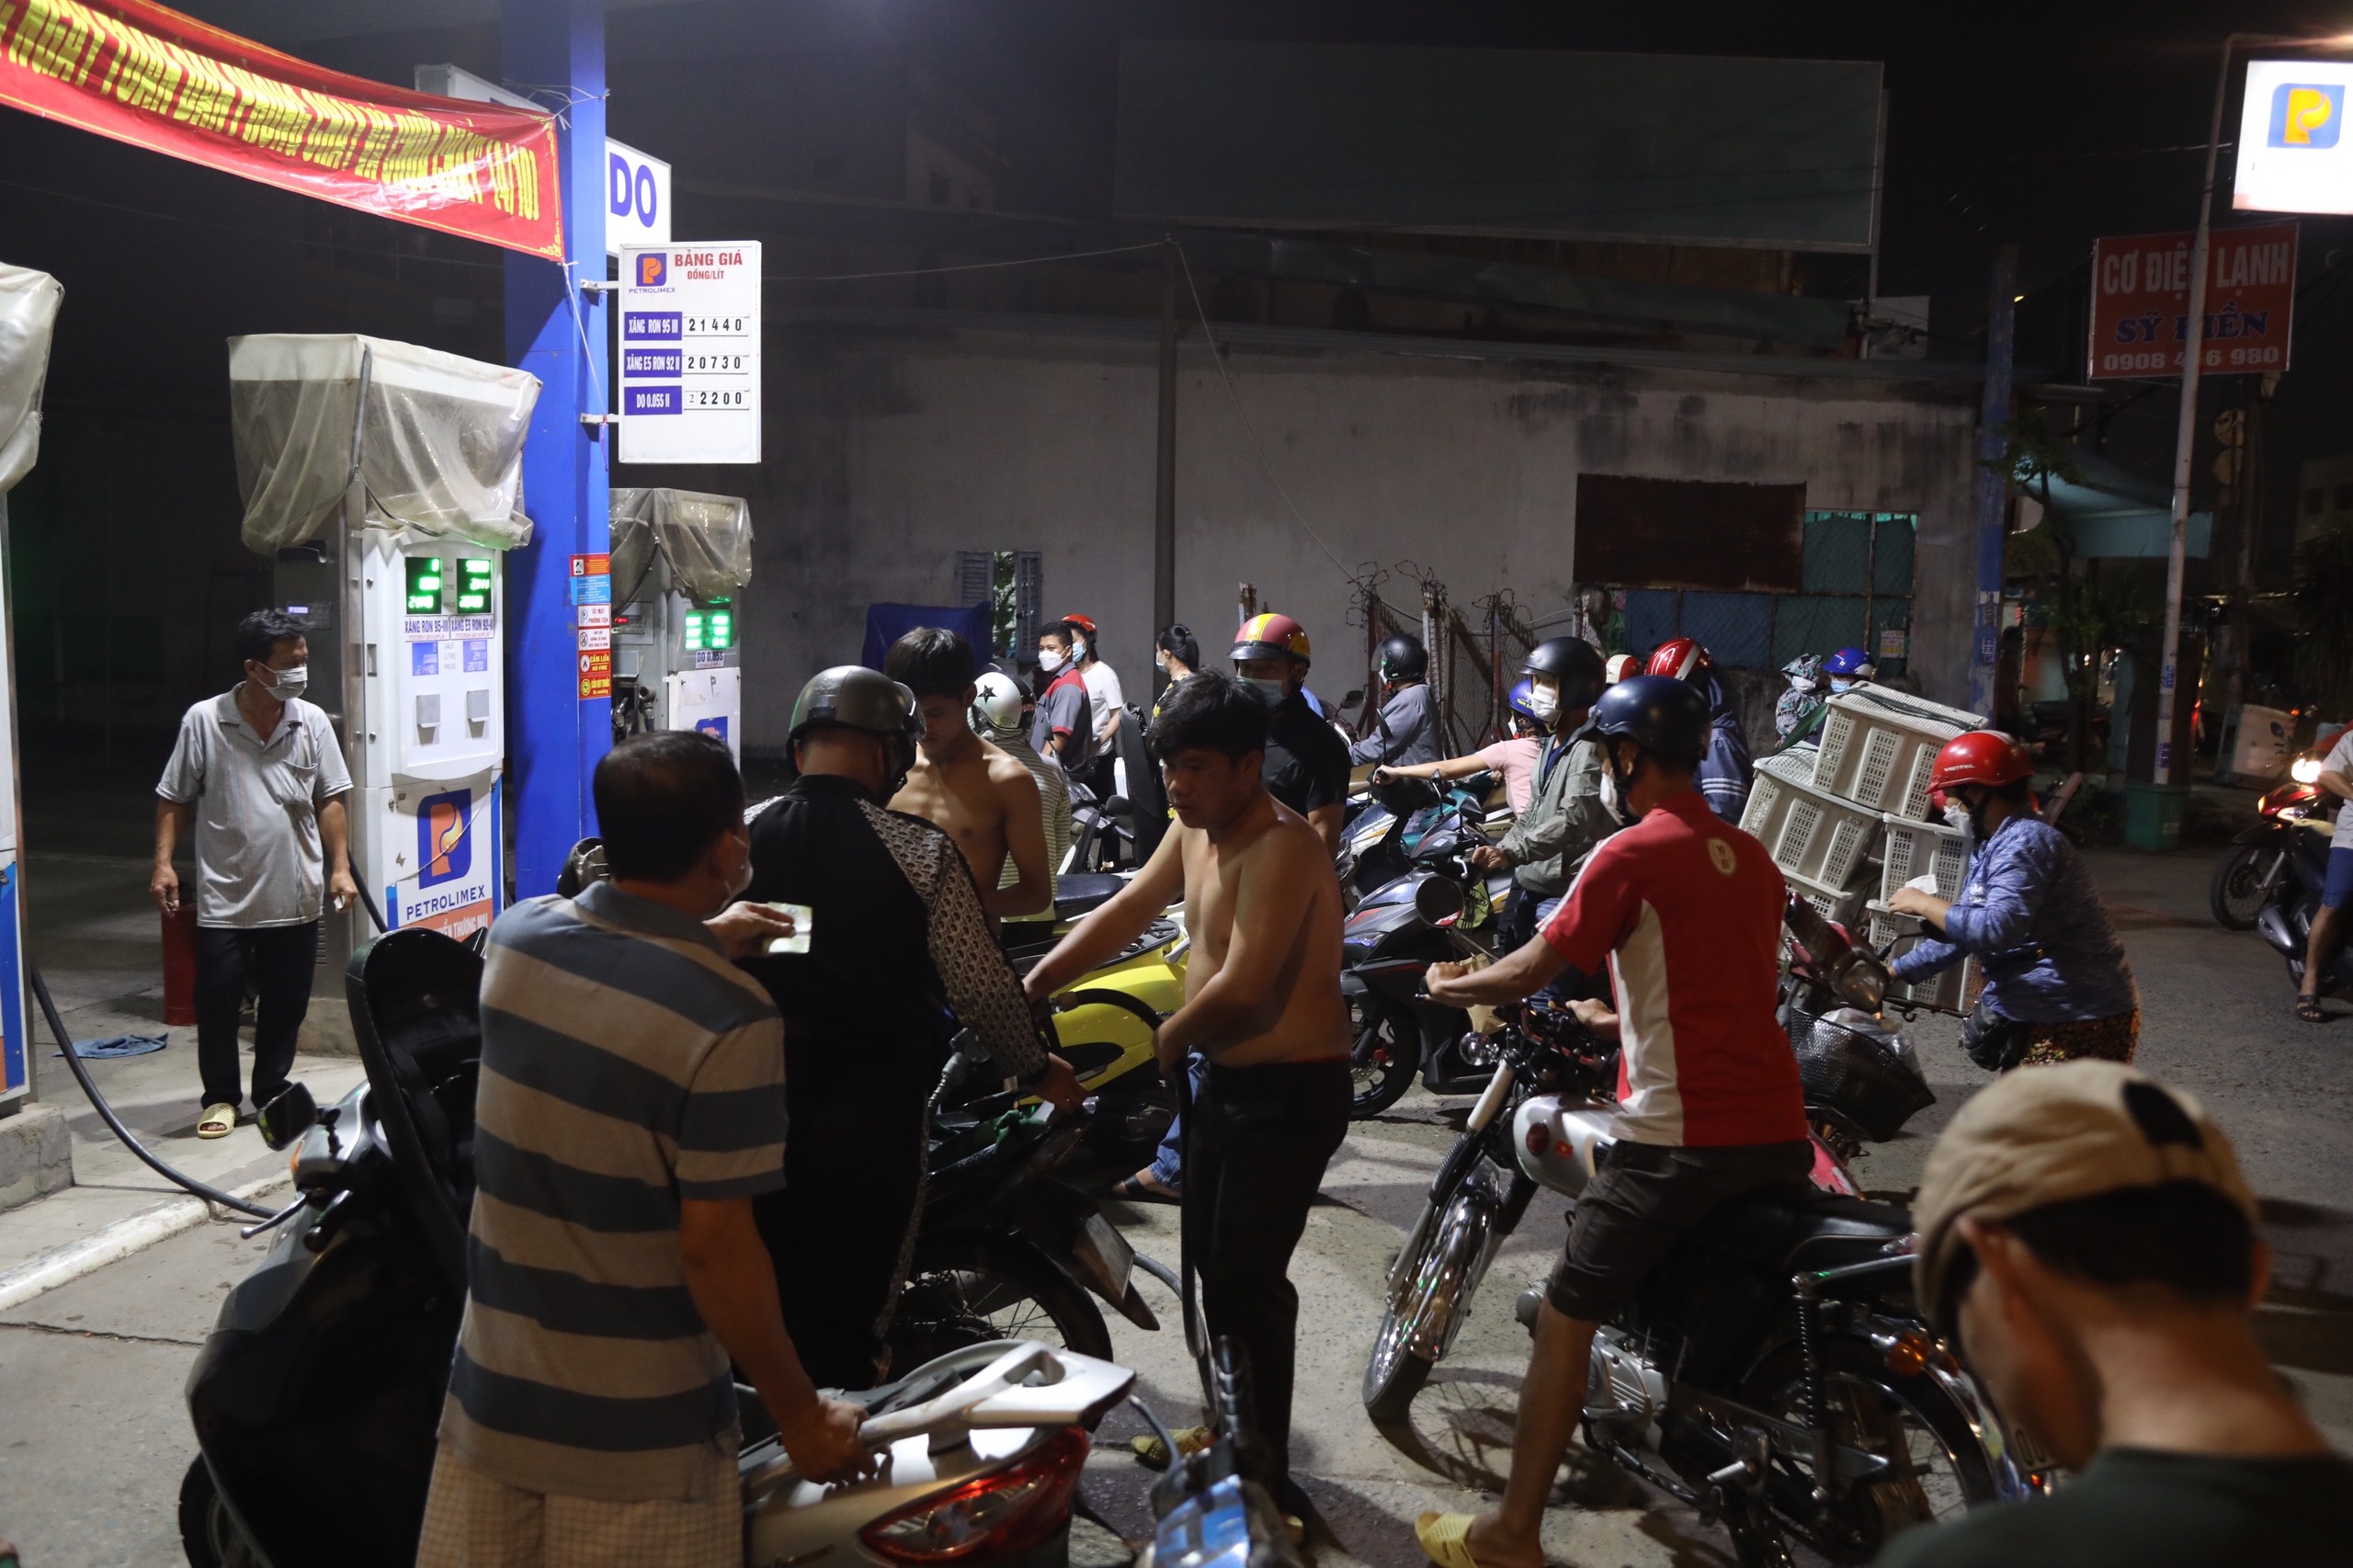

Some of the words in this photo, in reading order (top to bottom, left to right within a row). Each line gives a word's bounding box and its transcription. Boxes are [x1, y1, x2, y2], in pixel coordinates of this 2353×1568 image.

[609, 152, 657, 229] DO
[675, 250, 714, 267] BẢNG
[719, 250, 743, 267] GIÁ
[2103, 249, 2140, 295] CƠ
[2144, 242, 2194, 301] ĐIỆ
[2216, 243, 2290, 296] LẠNH
[648, 319, 661, 334] RON
[662, 319, 671, 334] 95
[688, 318, 742, 332] 21440
[2116, 310, 2164, 345] SỸ
[643, 357, 652, 370] E5
[653, 357, 665, 370] RON
[666, 357, 675, 370] 92
[688, 356, 741, 369] 20730
[2104, 353, 2165, 370] 0908
[2174, 349, 2222, 368] 46
[2231, 347, 2279, 365] 980
[636, 393, 645, 408] DO
[422, 621, 434, 633] RON
[465, 619, 472, 631] E5
[472, 619, 483, 631] RON
[697, 652, 706, 663] DO
[406, 884, 485, 921] PETROLIMEX
